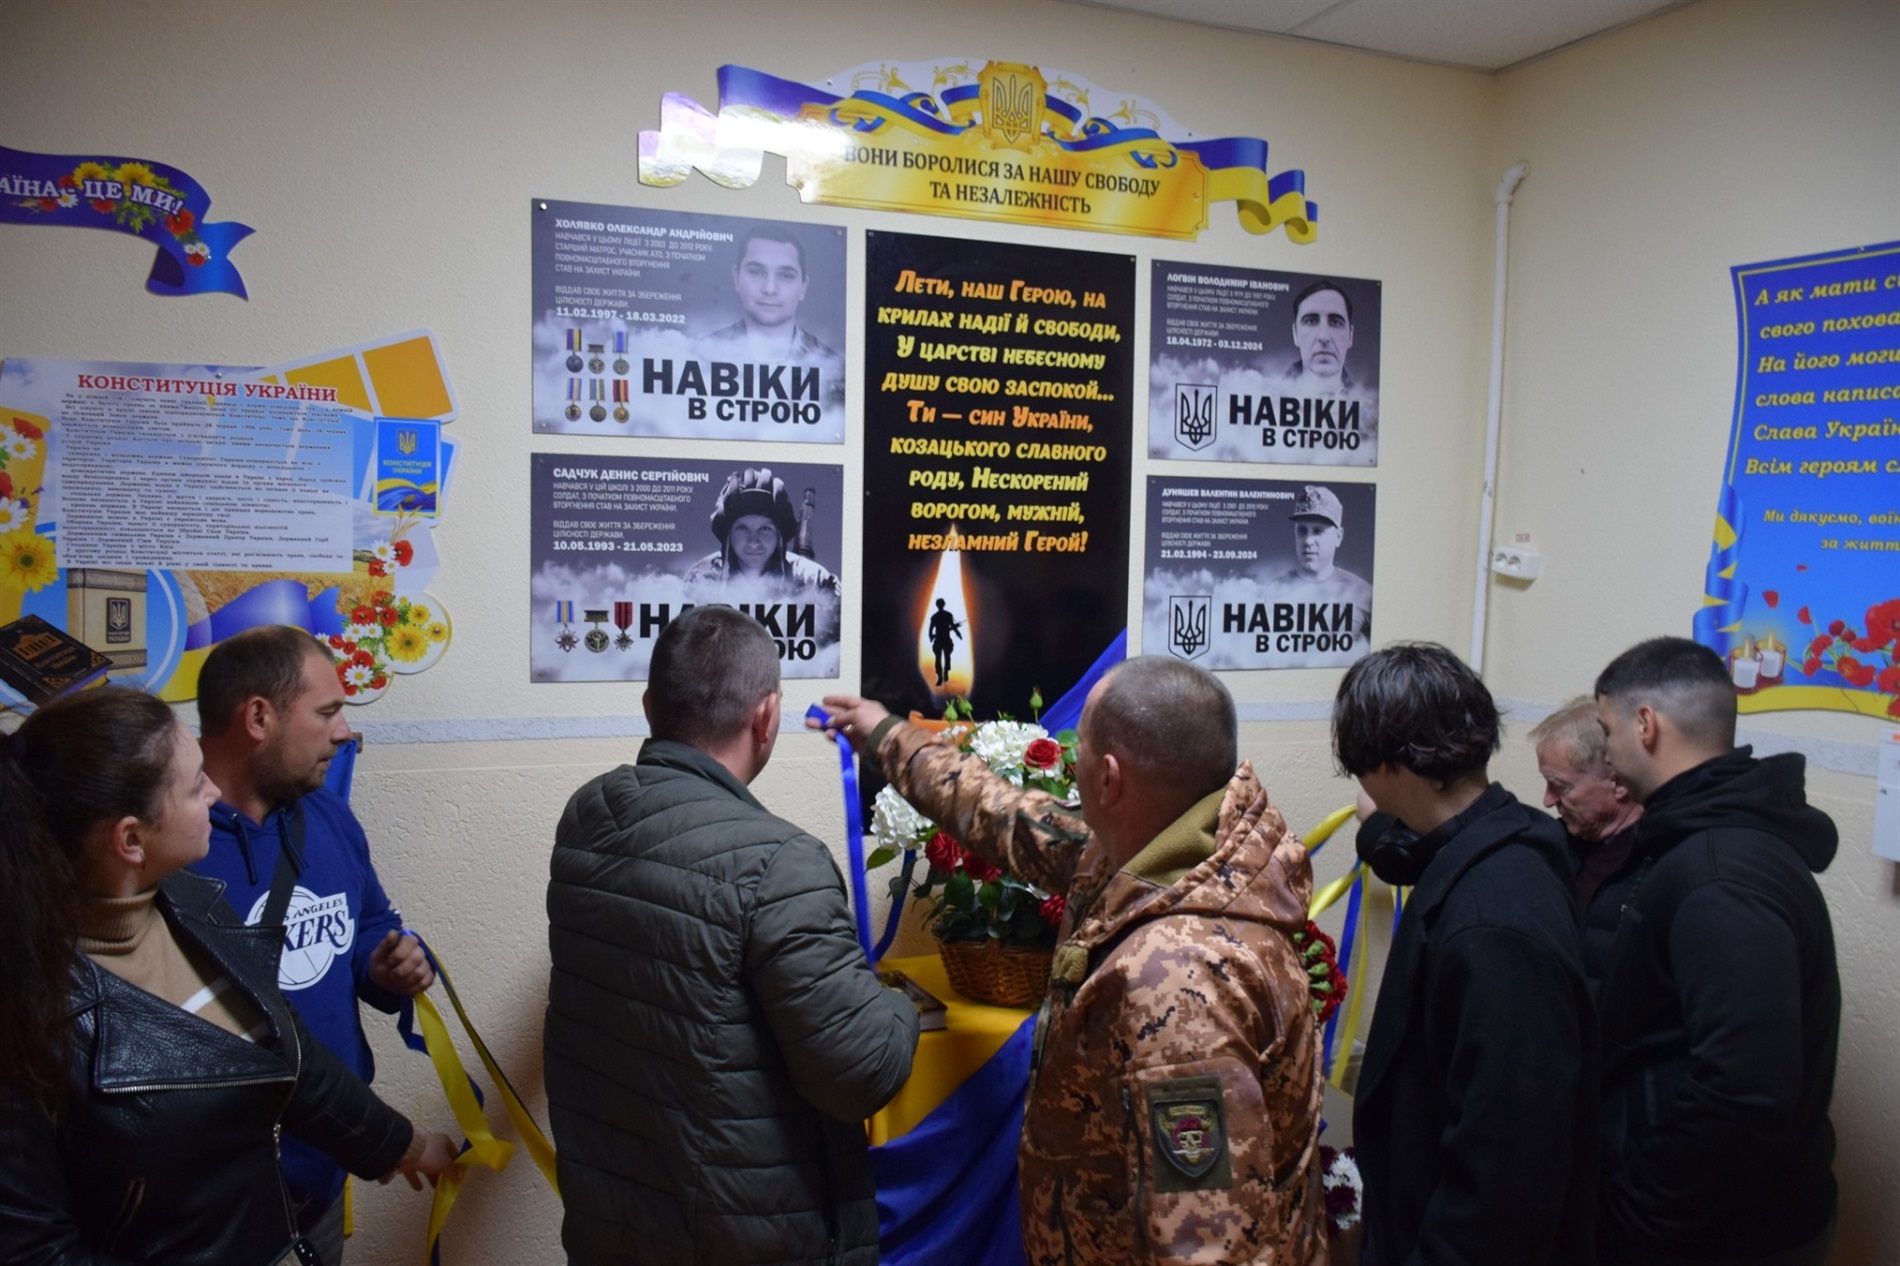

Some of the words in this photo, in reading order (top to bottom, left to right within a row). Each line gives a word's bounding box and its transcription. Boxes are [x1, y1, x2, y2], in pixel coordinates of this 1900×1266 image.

[845, 147, 898, 167] ВОНИ
[903, 152, 999, 178] БОРОЛИСЯ
[1003, 165, 1025, 181] ЗА
[1029, 167, 1080, 187] НАШУ
[1085, 175, 1160, 197] СВОБОДУ
[84, 180, 123, 200] ЦЕ
[130, 185, 184, 214] МИ!
[930, 181, 951, 198] ТА
[956, 186, 1091, 214] НЕЗАЛЕЖНІСТЬ
[555, 219, 604, 231] ХОЛЯВКО
[608, 223, 667, 236] ОЛЕКСАНДР
[670, 228, 733, 242] АНДРІЙОВИЧ
[1167, 273, 1196, 284] ЛОГВІН
[1198, 276, 1248, 288] ВОЛОДИМИР
[1250, 280, 1289, 292] ІВАНОВИЧ
[1754, 288, 1769, 306] А
[1774, 288, 1804, 304] як
[1809, 278, 1876, 299] мати
[556, 307, 616, 320] 11.02.1997
[627, 311, 685, 324] 18.03.2022
[1760, 321, 1816, 339] свого
[1822, 311, 1900, 333] похова
[1167, 336, 1212, 348] 18.04.1972
[1219, 339, 1262, 351] 03.12.2024
[1756, 356, 1786, 374] На
[1794, 352, 1840, 370] його
[78, 374, 237, 396] КОНСТИТУЦІЯ
[244, 384, 337, 402] УКРАЇНИ
[643, 358, 820, 401] НАВІКИ
[1755, 391, 1816, 407] слова
[688, 398, 706, 420] В
[716, 400, 821, 425] СТРОЮ
[1229, 394, 1360, 430] НАВІКИ
[1262, 428, 1276, 447] В
[1283, 429, 1360, 451] СТРОЮ
[1753, 424, 1817, 440] Слава
[553, 468, 598, 480] САДЧУК
[600, 469, 638, 481] ДЕНИС
[641, 470, 709, 482] СЕРГІЙОВИЧ
[1745, 457, 1792, 475] Всім
[1799, 459, 1877, 478] героям
[1763, 509, 1785, 522] Ми
[1790, 508, 1862, 526] дякуємо,
[554, 541, 614, 551] 10.05.1993
[623, 542, 683, 552] 21.05.2023
[1161, 550, 1207, 558] 21.02.1994
[1213, 551, 1257, 559] 23.09.2024
[1821, 539, 1838, 549] за
[1223, 603, 1353, 633] НАВІКИ
[1256, 634, 1269, 652] В
[1276, 634, 1353, 652] СТРОЮ
[293, 898, 343, 919] ANGELES
[284, 910, 349, 951] KERS
